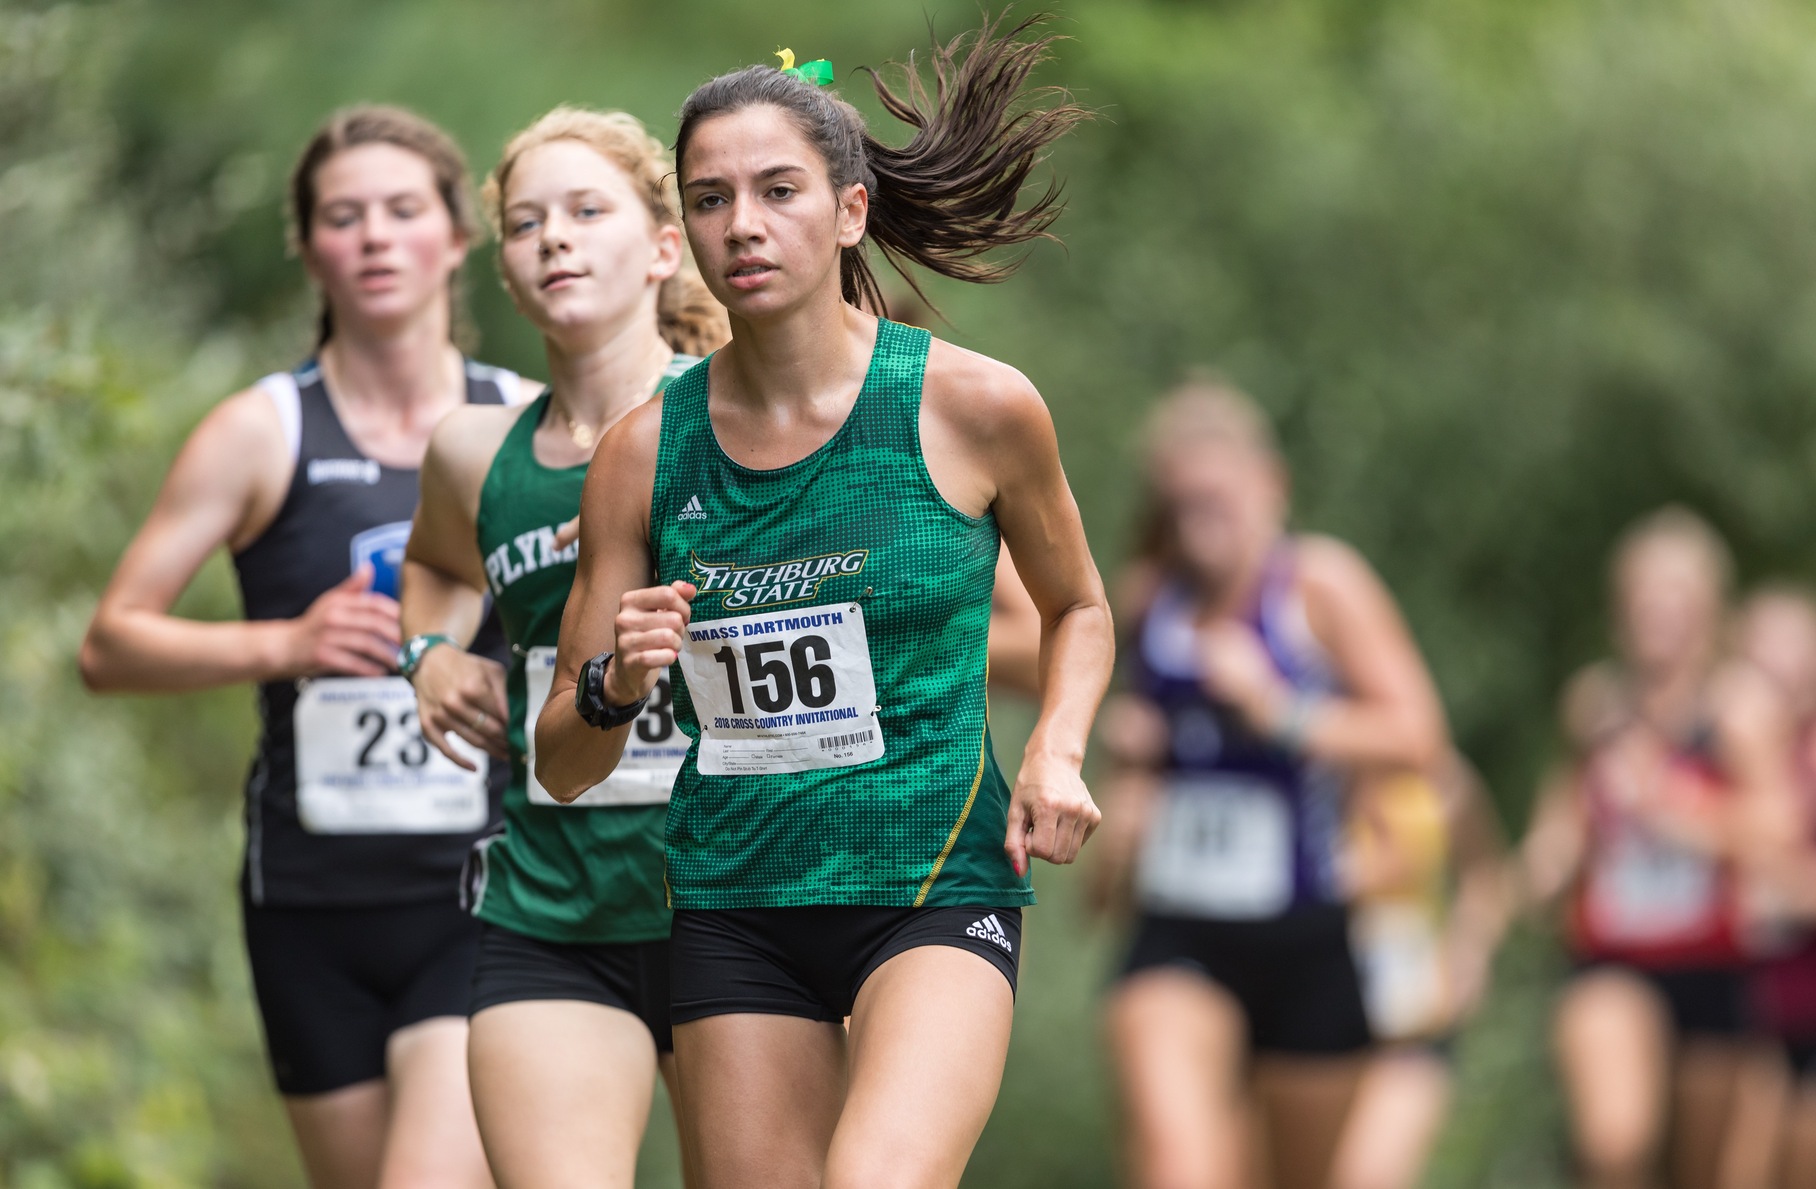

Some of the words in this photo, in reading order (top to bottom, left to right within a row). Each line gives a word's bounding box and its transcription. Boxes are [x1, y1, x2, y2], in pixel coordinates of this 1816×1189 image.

[678, 510, 707, 521] adidas
[485, 522, 579, 596] PLYM
[694, 553, 864, 590] FITCHBURG
[725, 577, 819, 607] STATE
[688, 625, 740, 642] UMASS
[743, 612, 843, 637] DARTMOUTH
[714, 635, 837, 714] 156
[714, 717, 731, 729] 2018
[730, 717, 755, 730] CROSS
[755, 715, 794, 729] COUNTRY
[795, 706, 859, 726] INVITATIONAL
[357, 708, 429, 768] 23
[966, 926, 1012, 953] adidas
